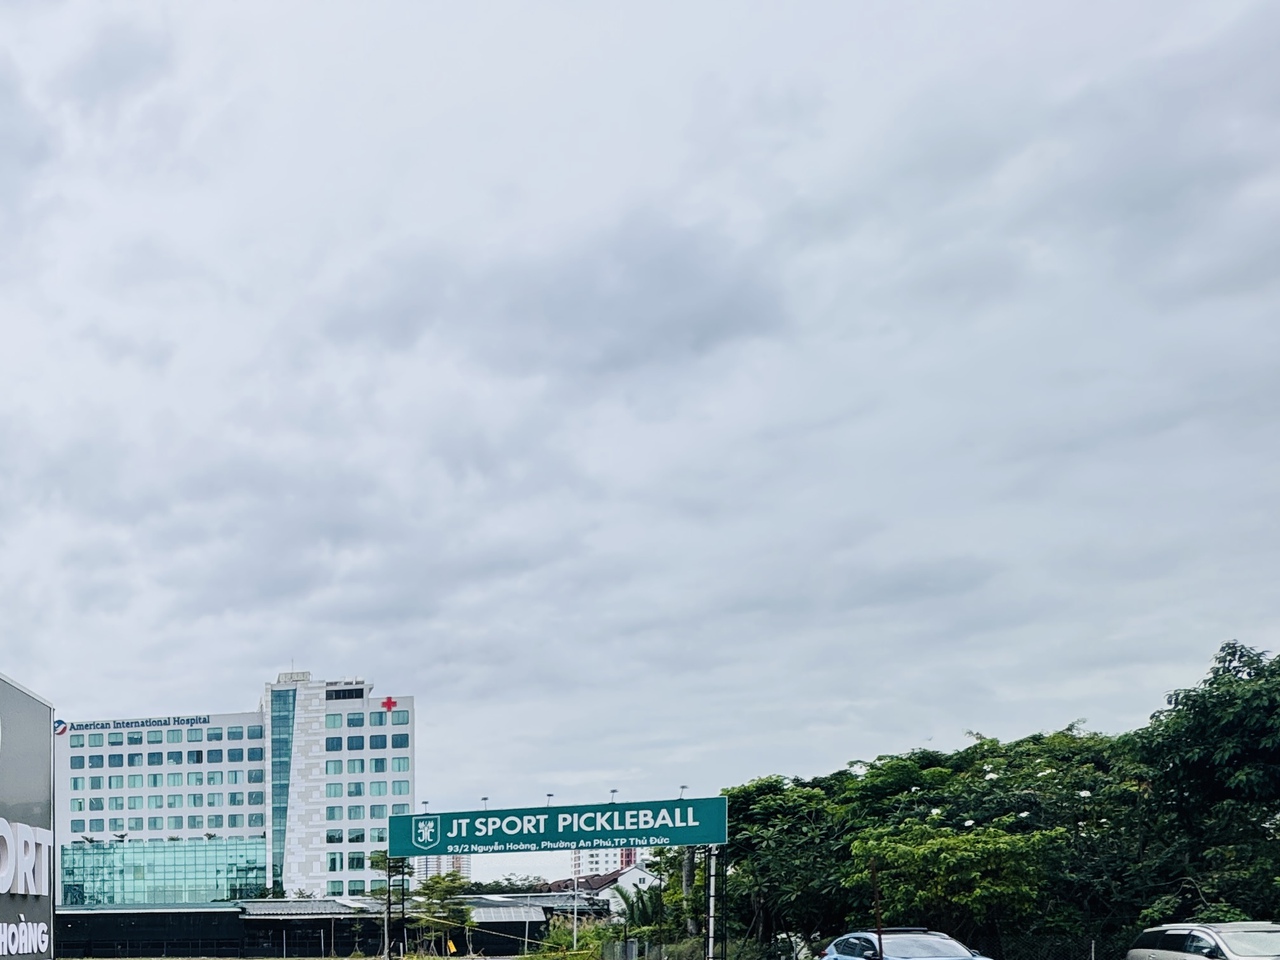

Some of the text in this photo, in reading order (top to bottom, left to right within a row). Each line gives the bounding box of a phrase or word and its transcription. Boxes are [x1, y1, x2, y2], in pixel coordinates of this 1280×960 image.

[69, 714, 210, 731] American International Hospital
[446, 806, 700, 838] JT SPORT PICKLEBALL
[446, 843, 470, 853] 93/2
[470, 841, 505, 853] Nguyễn
[541, 839, 577, 850] Phường
[578, 839, 592, 848] An
[628, 836, 648, 846] Thủ
[649, 835, 670, 845] Đức
